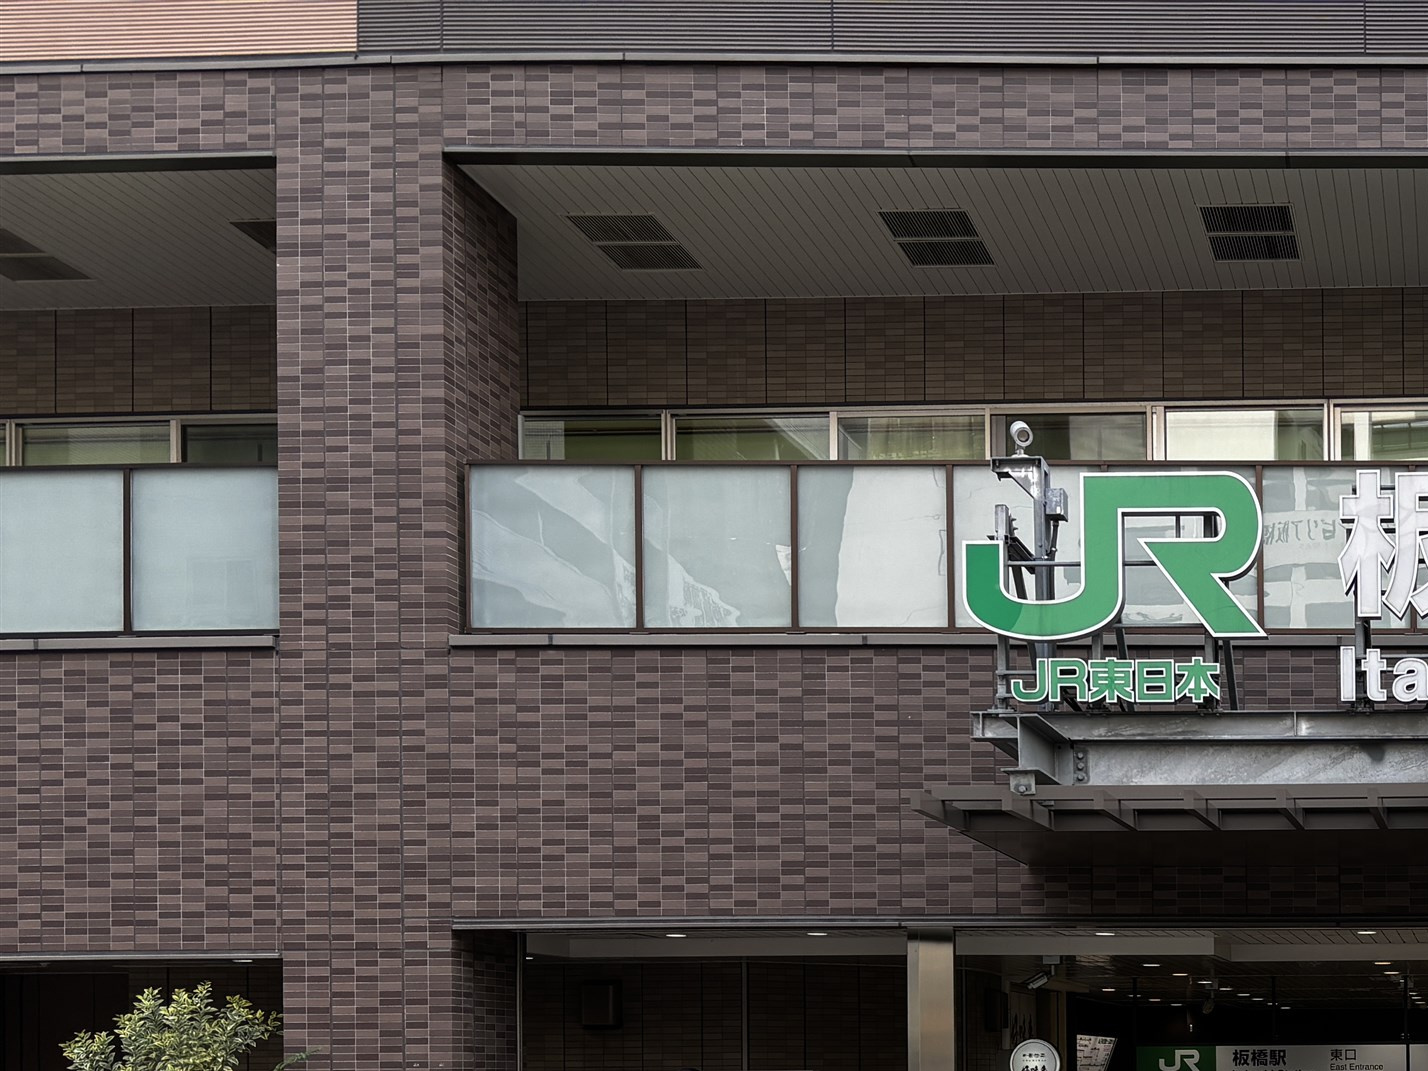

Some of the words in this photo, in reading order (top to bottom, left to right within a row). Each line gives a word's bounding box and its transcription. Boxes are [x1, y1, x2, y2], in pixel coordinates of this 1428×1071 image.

[962, 470, 1268, 640] JR
[1010, 657, 1221, 703] JR東日本
[1158, 1049, 1200, 1071] JR
[1232, 1049, 1287, 1067] 板橋駅
[1330, 1049, 1357, 1061] 東口
[1330, 1063, 1348, 1071] East
[1350, 1063, 1384, 1071] Entrance
